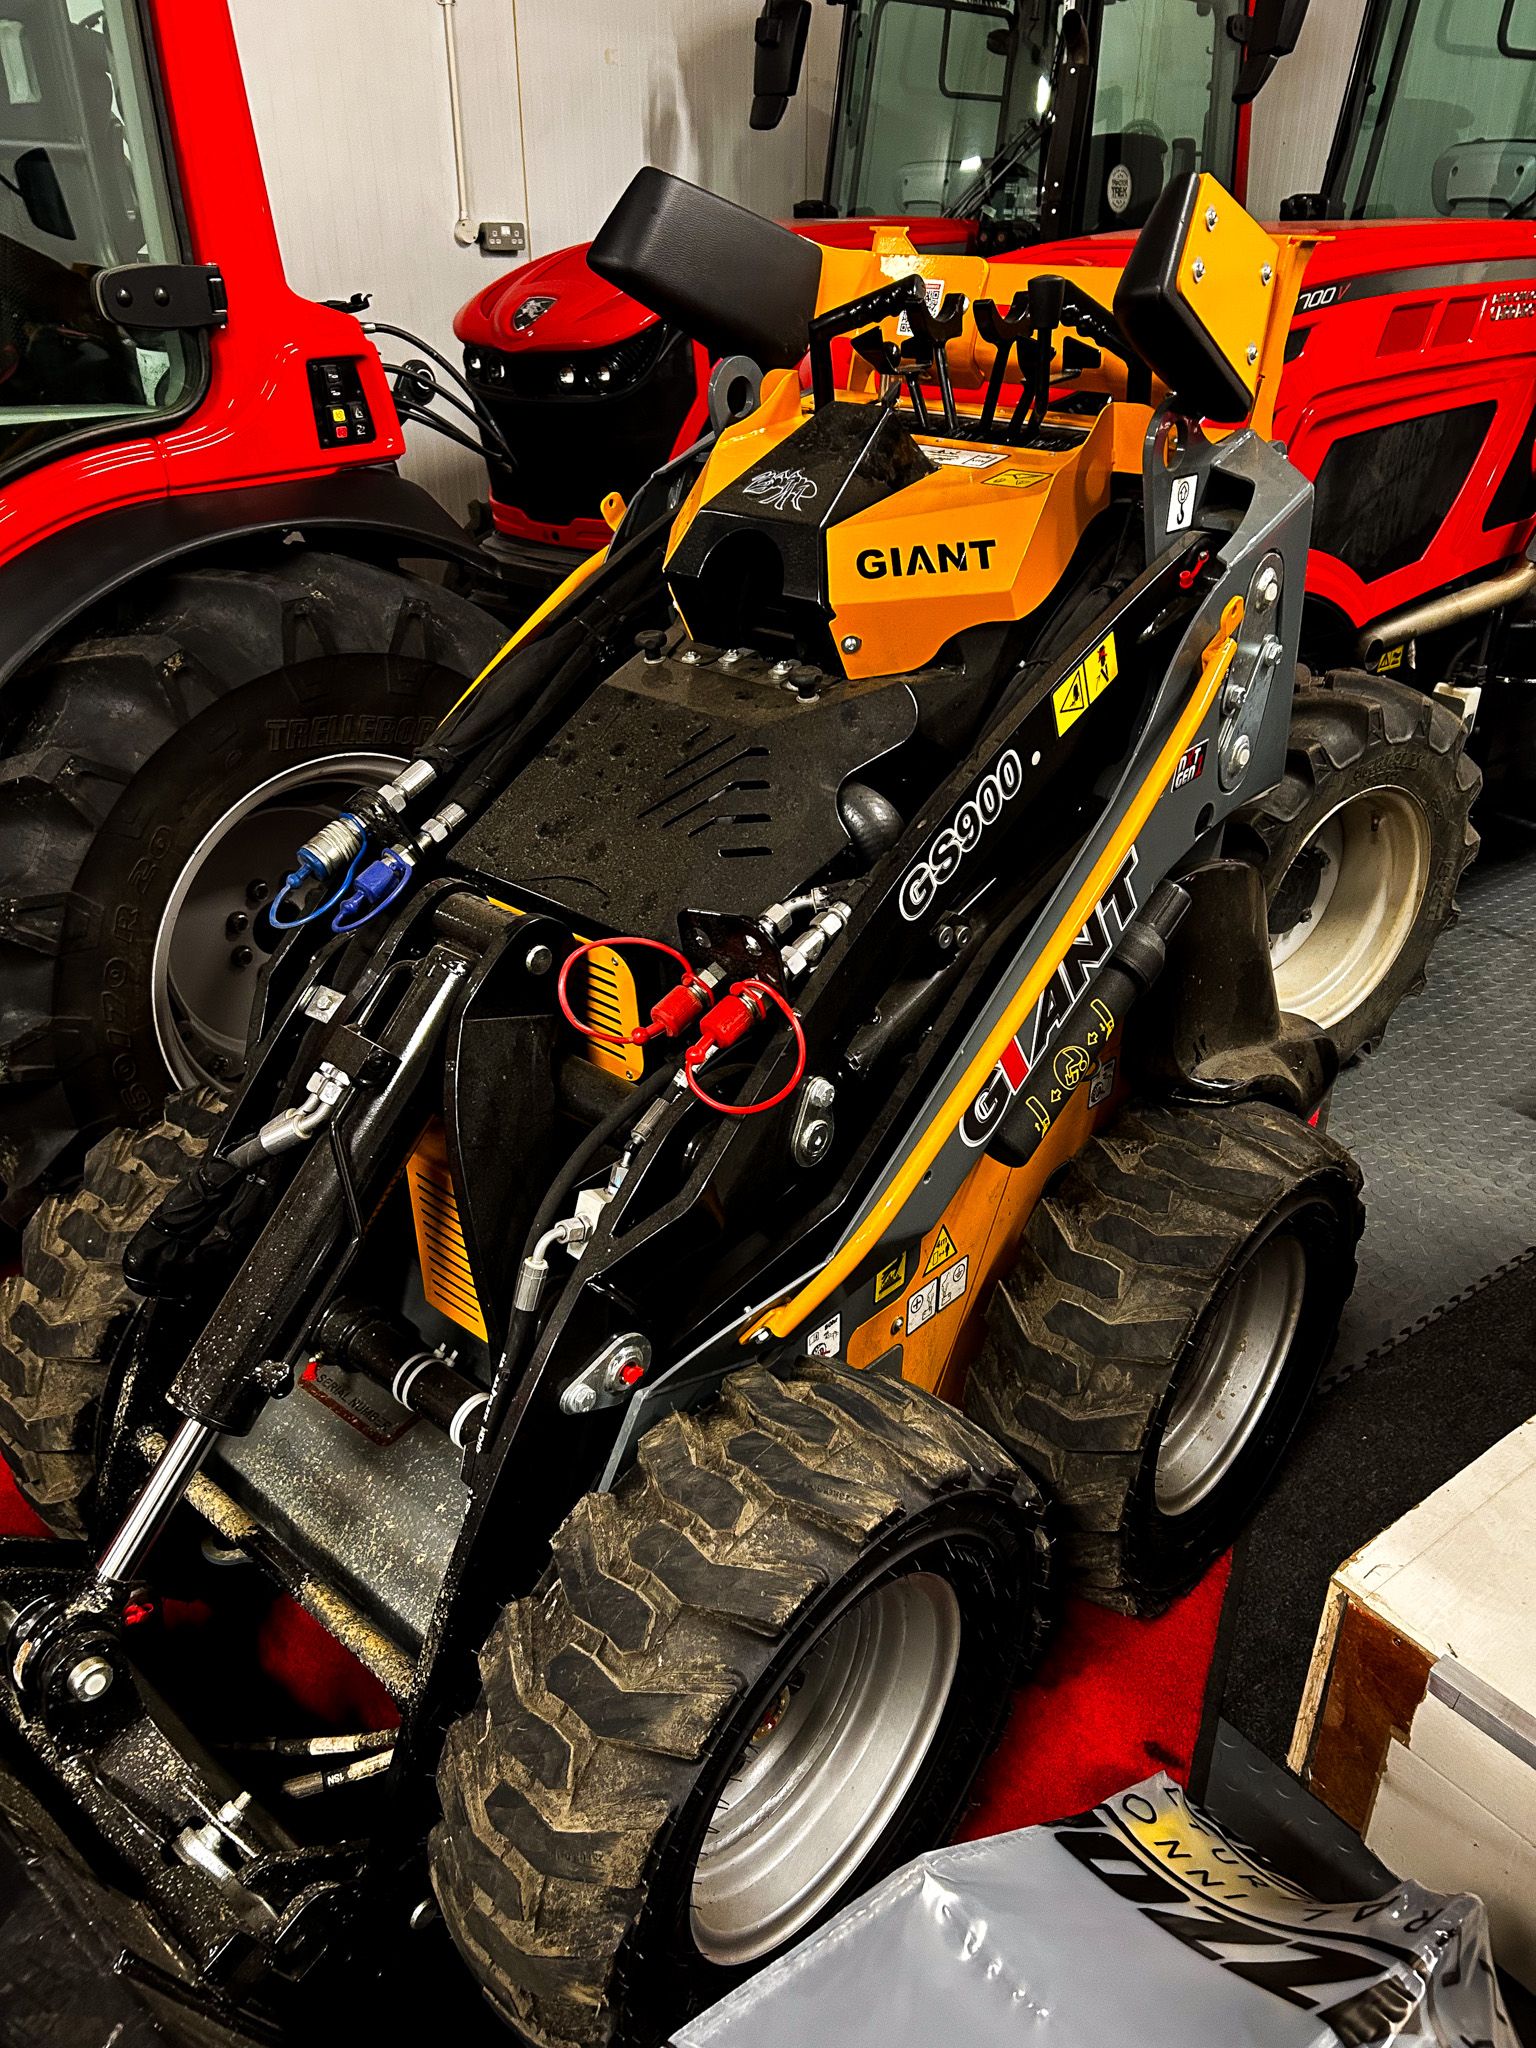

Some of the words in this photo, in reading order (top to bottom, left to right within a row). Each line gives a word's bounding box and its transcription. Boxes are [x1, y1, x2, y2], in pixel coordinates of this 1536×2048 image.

[856, 539, 997, 579] GIANT
[898, 749, 1023, 922] GS900
[958, 844, 1139, 1148] GIANT
